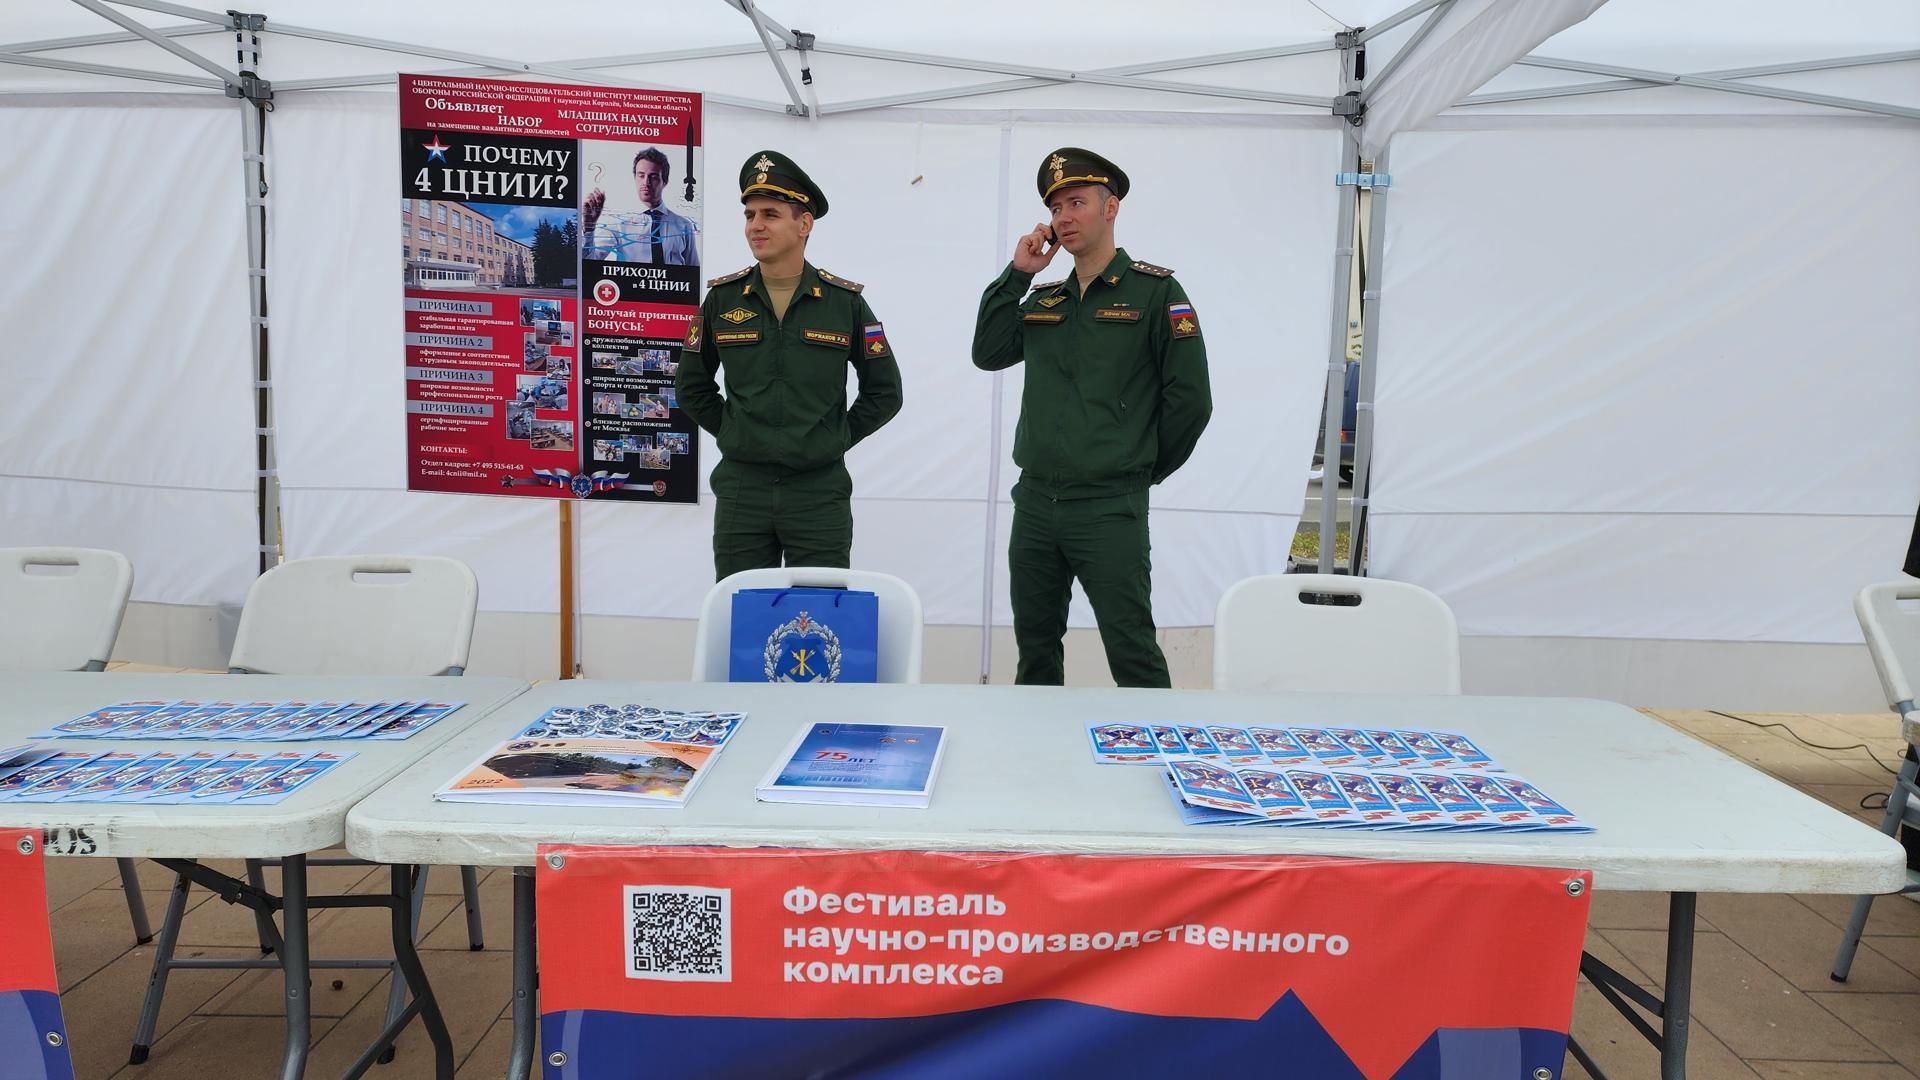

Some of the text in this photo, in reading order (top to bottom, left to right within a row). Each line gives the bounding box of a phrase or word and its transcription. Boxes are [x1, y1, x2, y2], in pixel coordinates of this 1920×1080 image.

[417, 80, 474, 90] ЦЕНТРАЛЬНЫЙ
[475, 83, 593, 97] НАУЧНО-ИССЛЕДОВАТЕЛЬСКИЙ
[593, 91, 632, 100] ИНСТИТУТ
[633, 94, 692, 104] МИНИСТЕРСТВА
[412, 87, 451, 96] ОБОРОНЫ
[452, 89, 504, 99] РОССИЙСКОЙ
[505, 94, 550, 103] ФЕДЕРАЦИИ
[623, 101, 662, 110] Московская
[425, 97, 505, 114] Объявляет
[497, 115, 543, 127] НАБОР
[558, 109, 679, 126] МЛАДШИХ НАУЧНЫХ
[437, 122, 481, 131] замещение
[481, 125, 523, 134] вакантных
[523, 127, 570, 136] должностей
[575, 122, 660, 137] СОТРУДНИКОВ
[463, 144, 571, 172] ПОЧЕМУ
[414, 167, 569, 200] 4 ЦНИИ?
[602, 265, 667, 279] ПРИХОДИ
[638, 279, 646, 289] 4
[648, 279, 690, 292] ЦНИИ
[419, 300, 476, 312] ПРИЧИНА
[419, 314, 514, 326] стабильная гарантированная
[587, 306, 695, 322] Получай приятные
[419, 322, 456, 331] заработная
[587, 320, 645, 332] БОНУСЫ:
[419, 335, 483, 347] ПРИЧИНА 2
[419, 349, 461, 358] оформление
[467, 352, 510, 360] соответствии
[423, 357, 458, 366] трудовым
[458, 359, 521, 368] законодательством
[419, 369, 483, 382] ПРИЧИНА 3
[592, 375, 625, 383] широкие
[625, 377, 672, 385] возможности
[420, 383, 494, 393] широкие возможности
[420, 390, 485, 400] профессионального
[420, 403, 484, 415] ПРИЧИНА 4
[420, 416, 489, 427] сертифицированные
[592, 418, 672, 428] близкое расположение
[420, 425, 448, 433] рабочие
[602, 425, 630, 433] Москвы
[420, 445, 468, 454] КОНТАКТЫ:
[421, 459, 443, 468] Отдел
[444, 461, 471, 470] кадров:
[421, 468, 446, 477] E-mail:
[815, 751, 849, 761] 75
[783, 885, 1007, 917] Фестиваль
[783, 924, 1350, 958] научно-производственного
[783, 961, 1004, 986] комплекса
